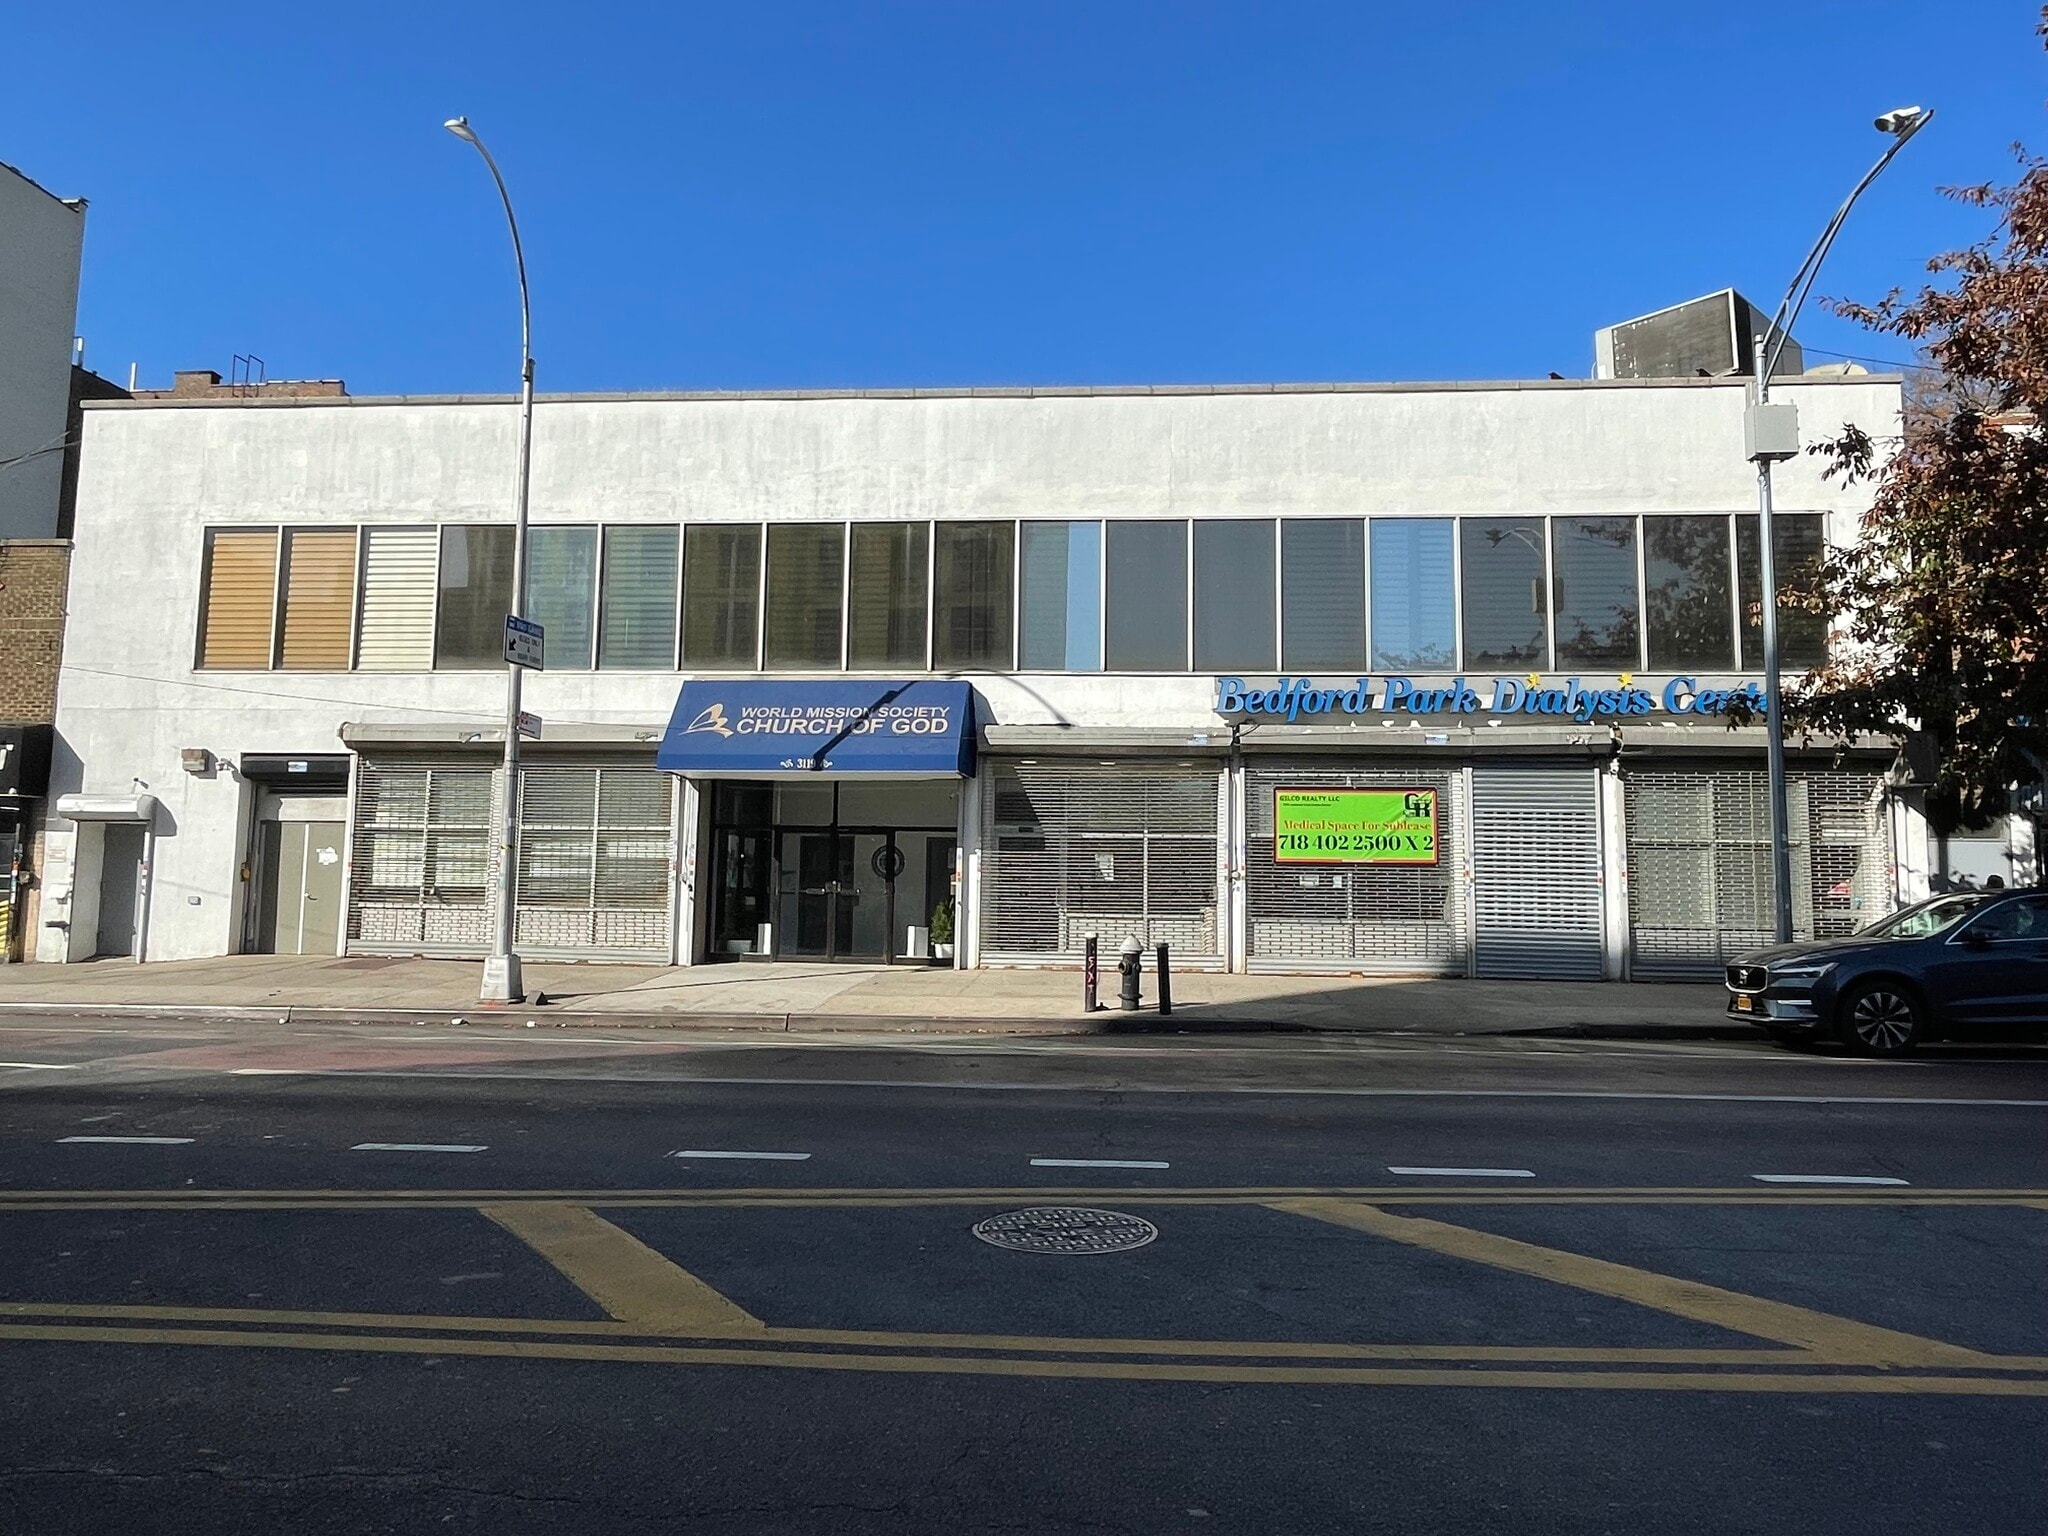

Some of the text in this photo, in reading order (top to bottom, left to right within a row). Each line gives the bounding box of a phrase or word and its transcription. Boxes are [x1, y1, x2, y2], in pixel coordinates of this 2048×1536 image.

[1213, 672, 1769, 723] Bedford Park Dialysis Cent
[741, 706, 950, 718] WORLD MISSION SOCIETY
[736, 718, 949, 734] CHURCH OF GOD
[797, 758, 817, 769] 3119
[1284, 820, 1431, 832] Medical Space For Sublease
[1279, 835, 1434, 850] 718 402 2500 X 2
